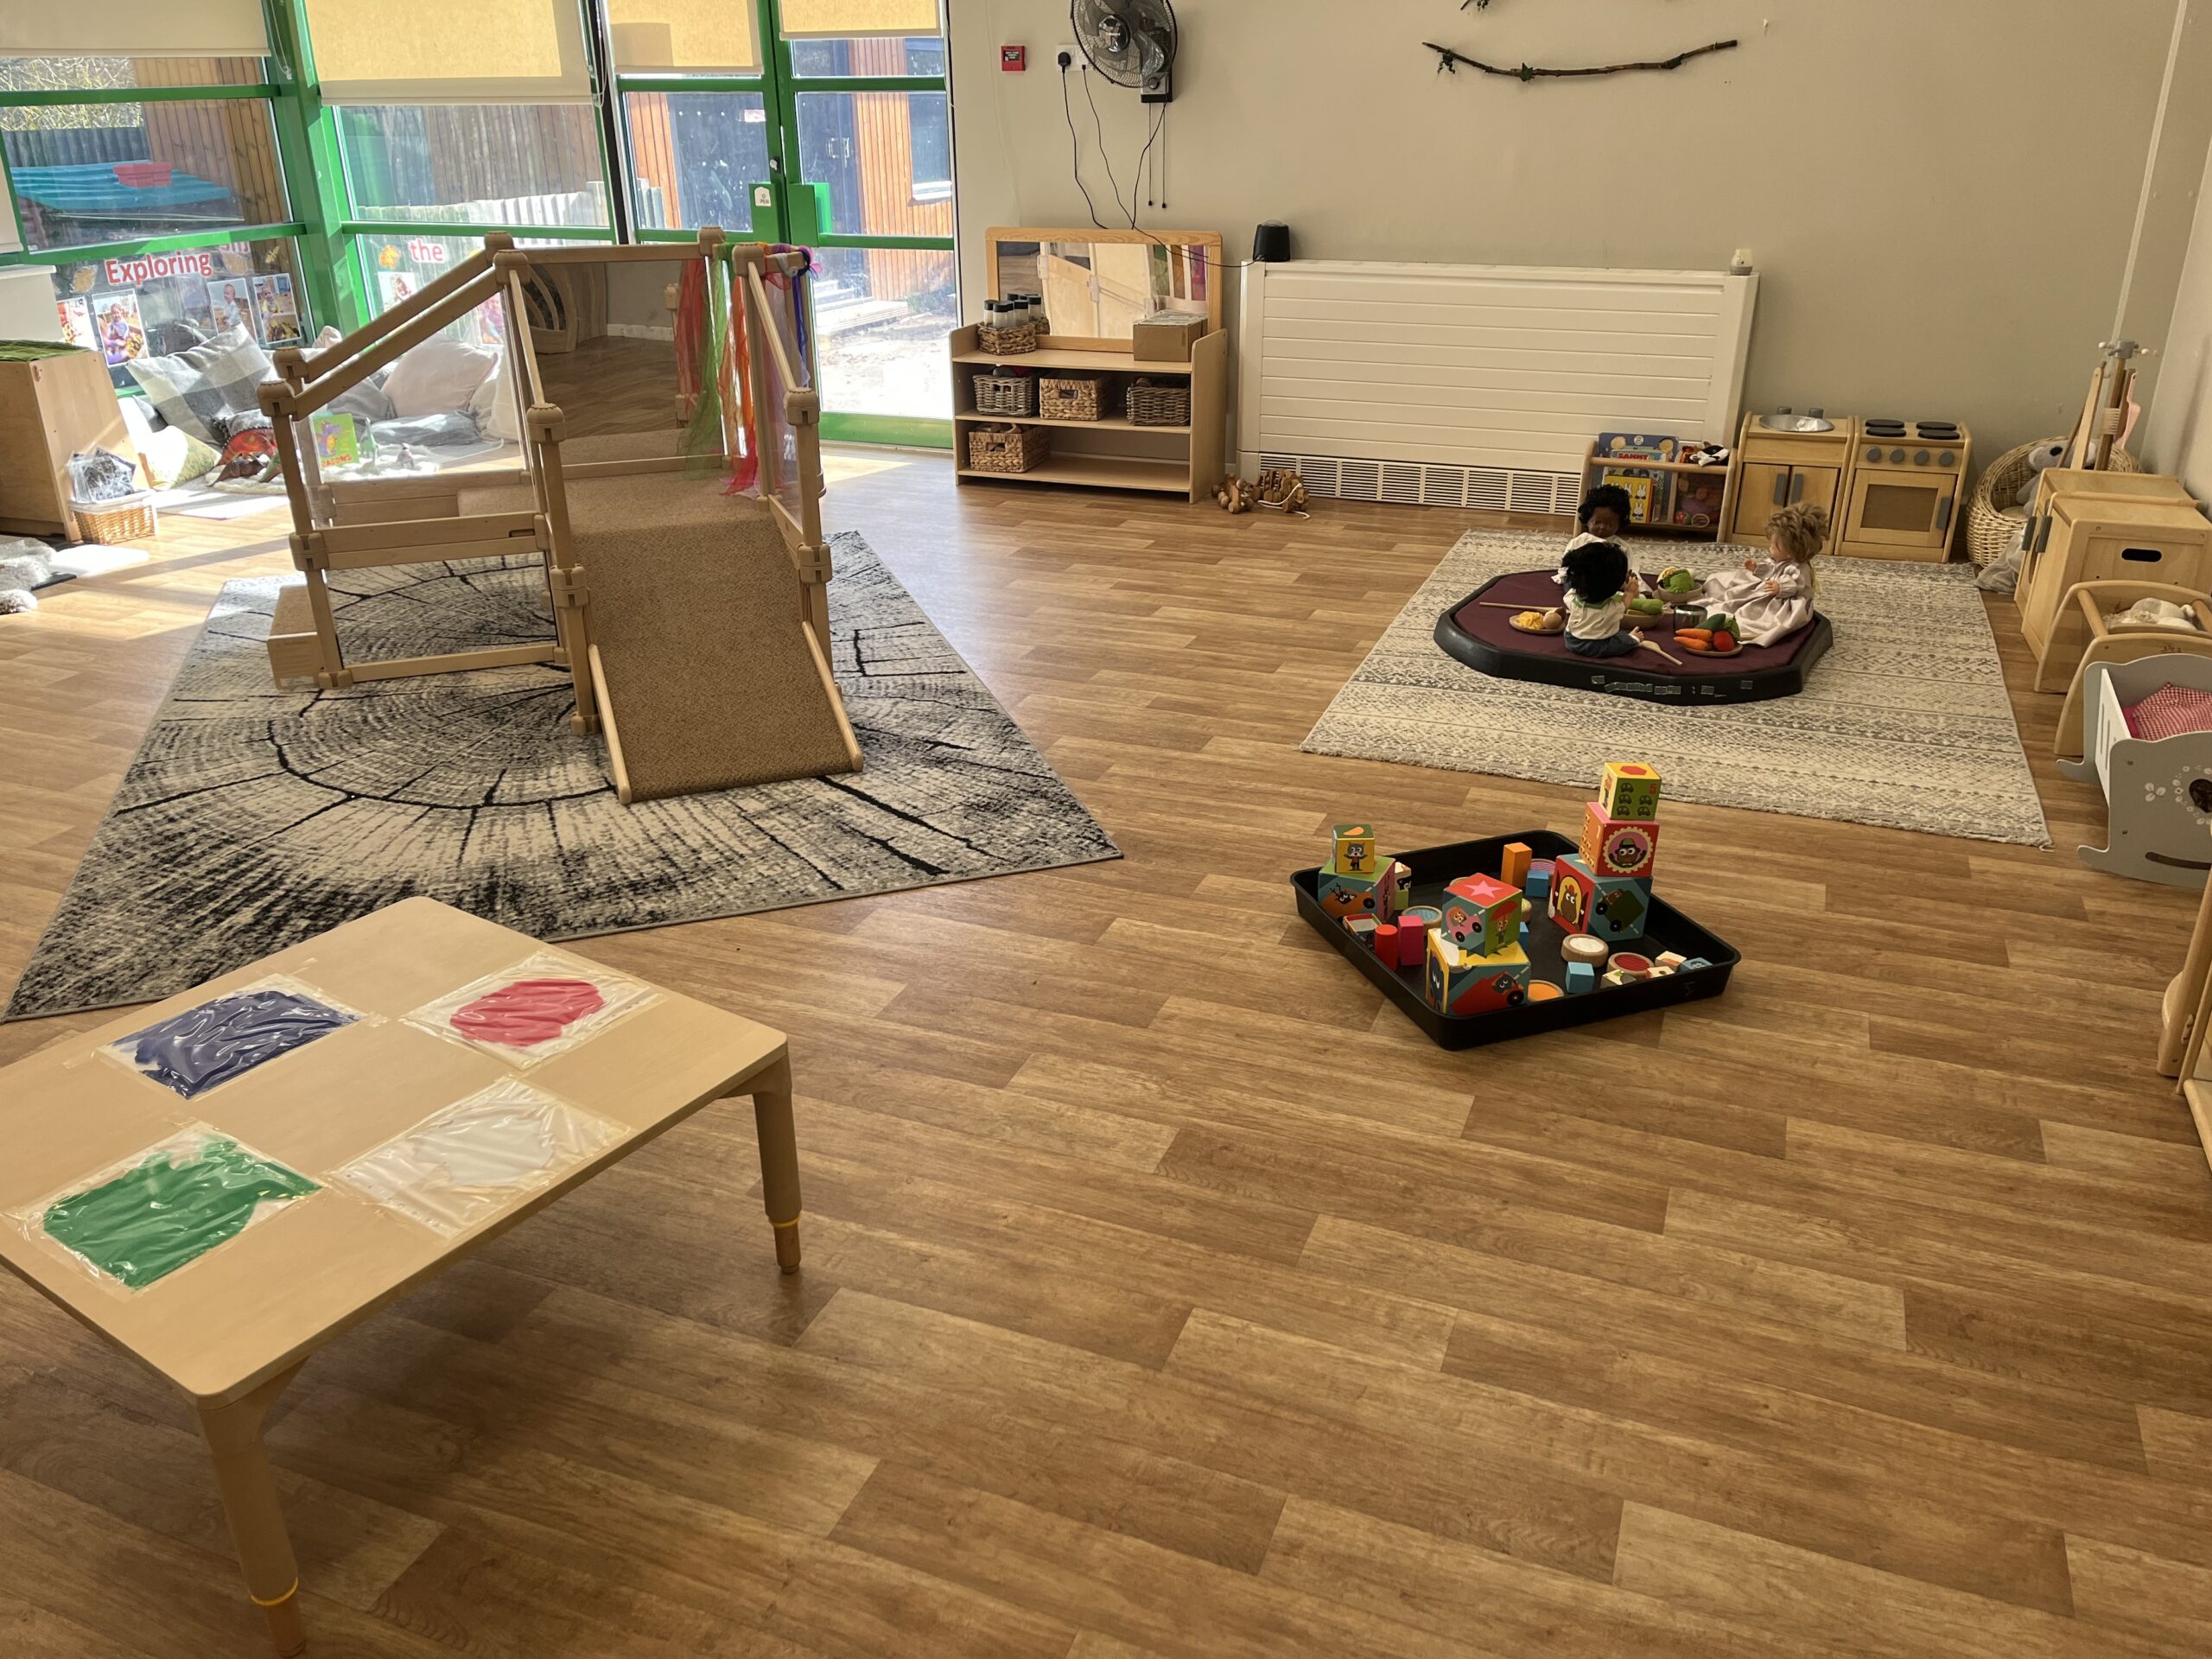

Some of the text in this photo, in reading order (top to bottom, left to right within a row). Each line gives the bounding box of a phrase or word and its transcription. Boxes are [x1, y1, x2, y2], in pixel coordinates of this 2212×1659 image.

[105, 238, 443, 286] Exploring the
[1649, 784, 1656, 794] 5
